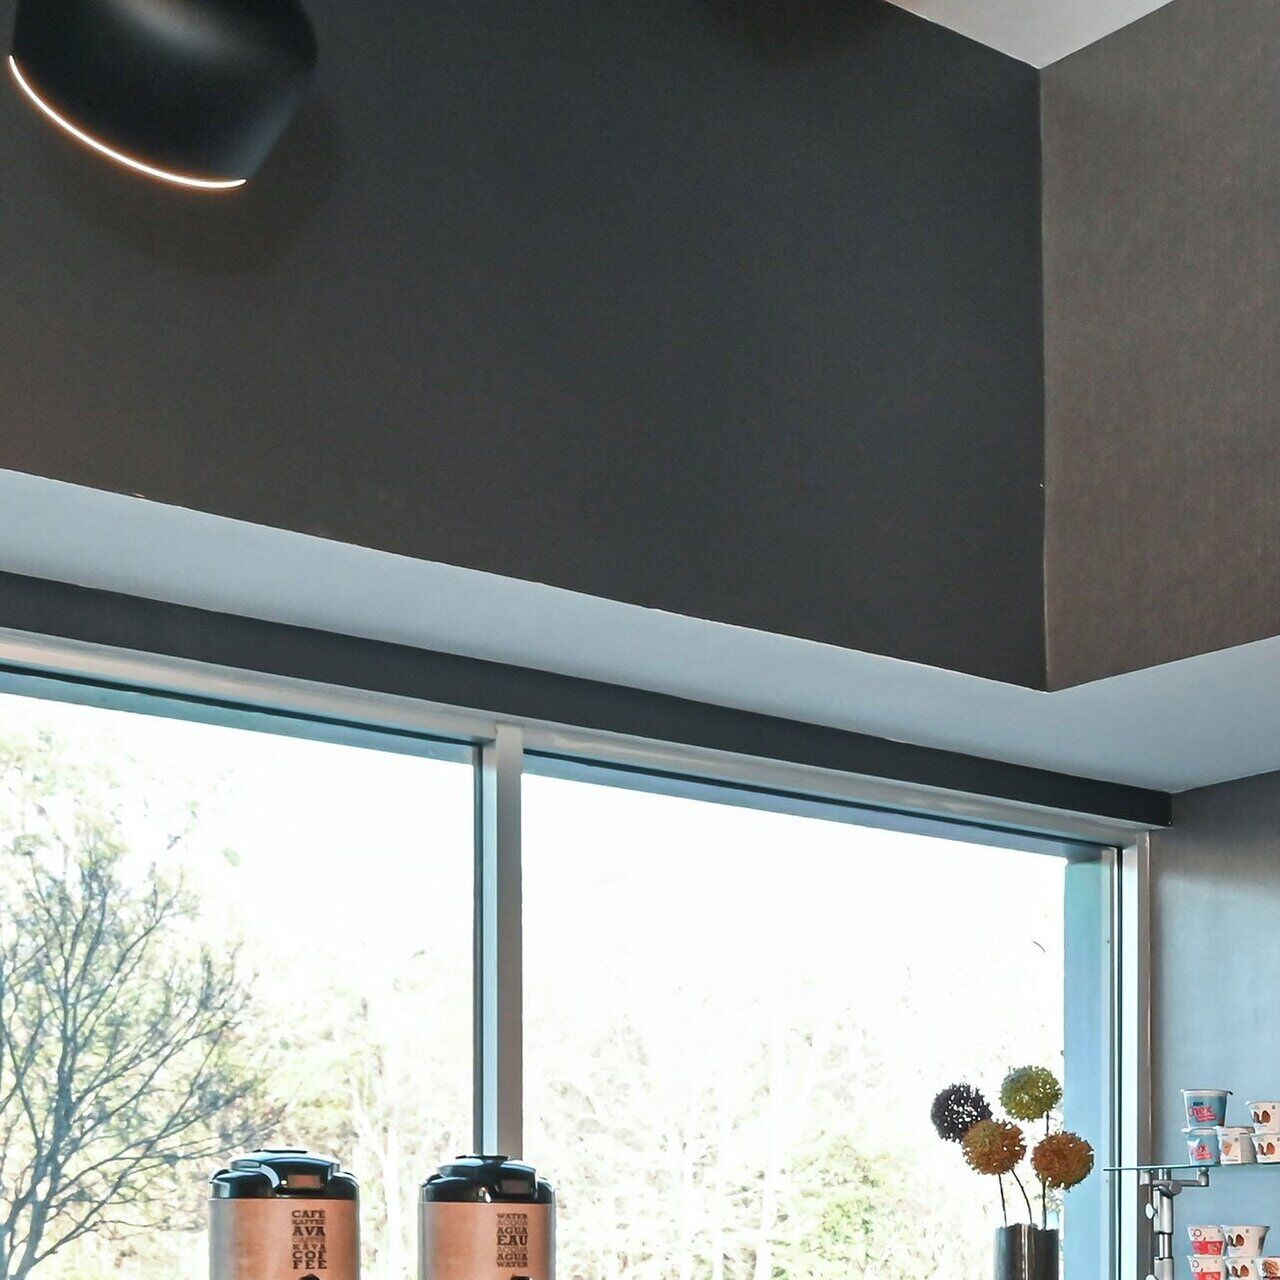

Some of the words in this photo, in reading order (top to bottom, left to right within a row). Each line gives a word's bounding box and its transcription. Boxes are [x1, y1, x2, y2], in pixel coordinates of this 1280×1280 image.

[496, 1227, 528, 1235] AGUA
[496, 1235, 528, 1246] EAU
[292, 1260, 328, 1270] FEE
